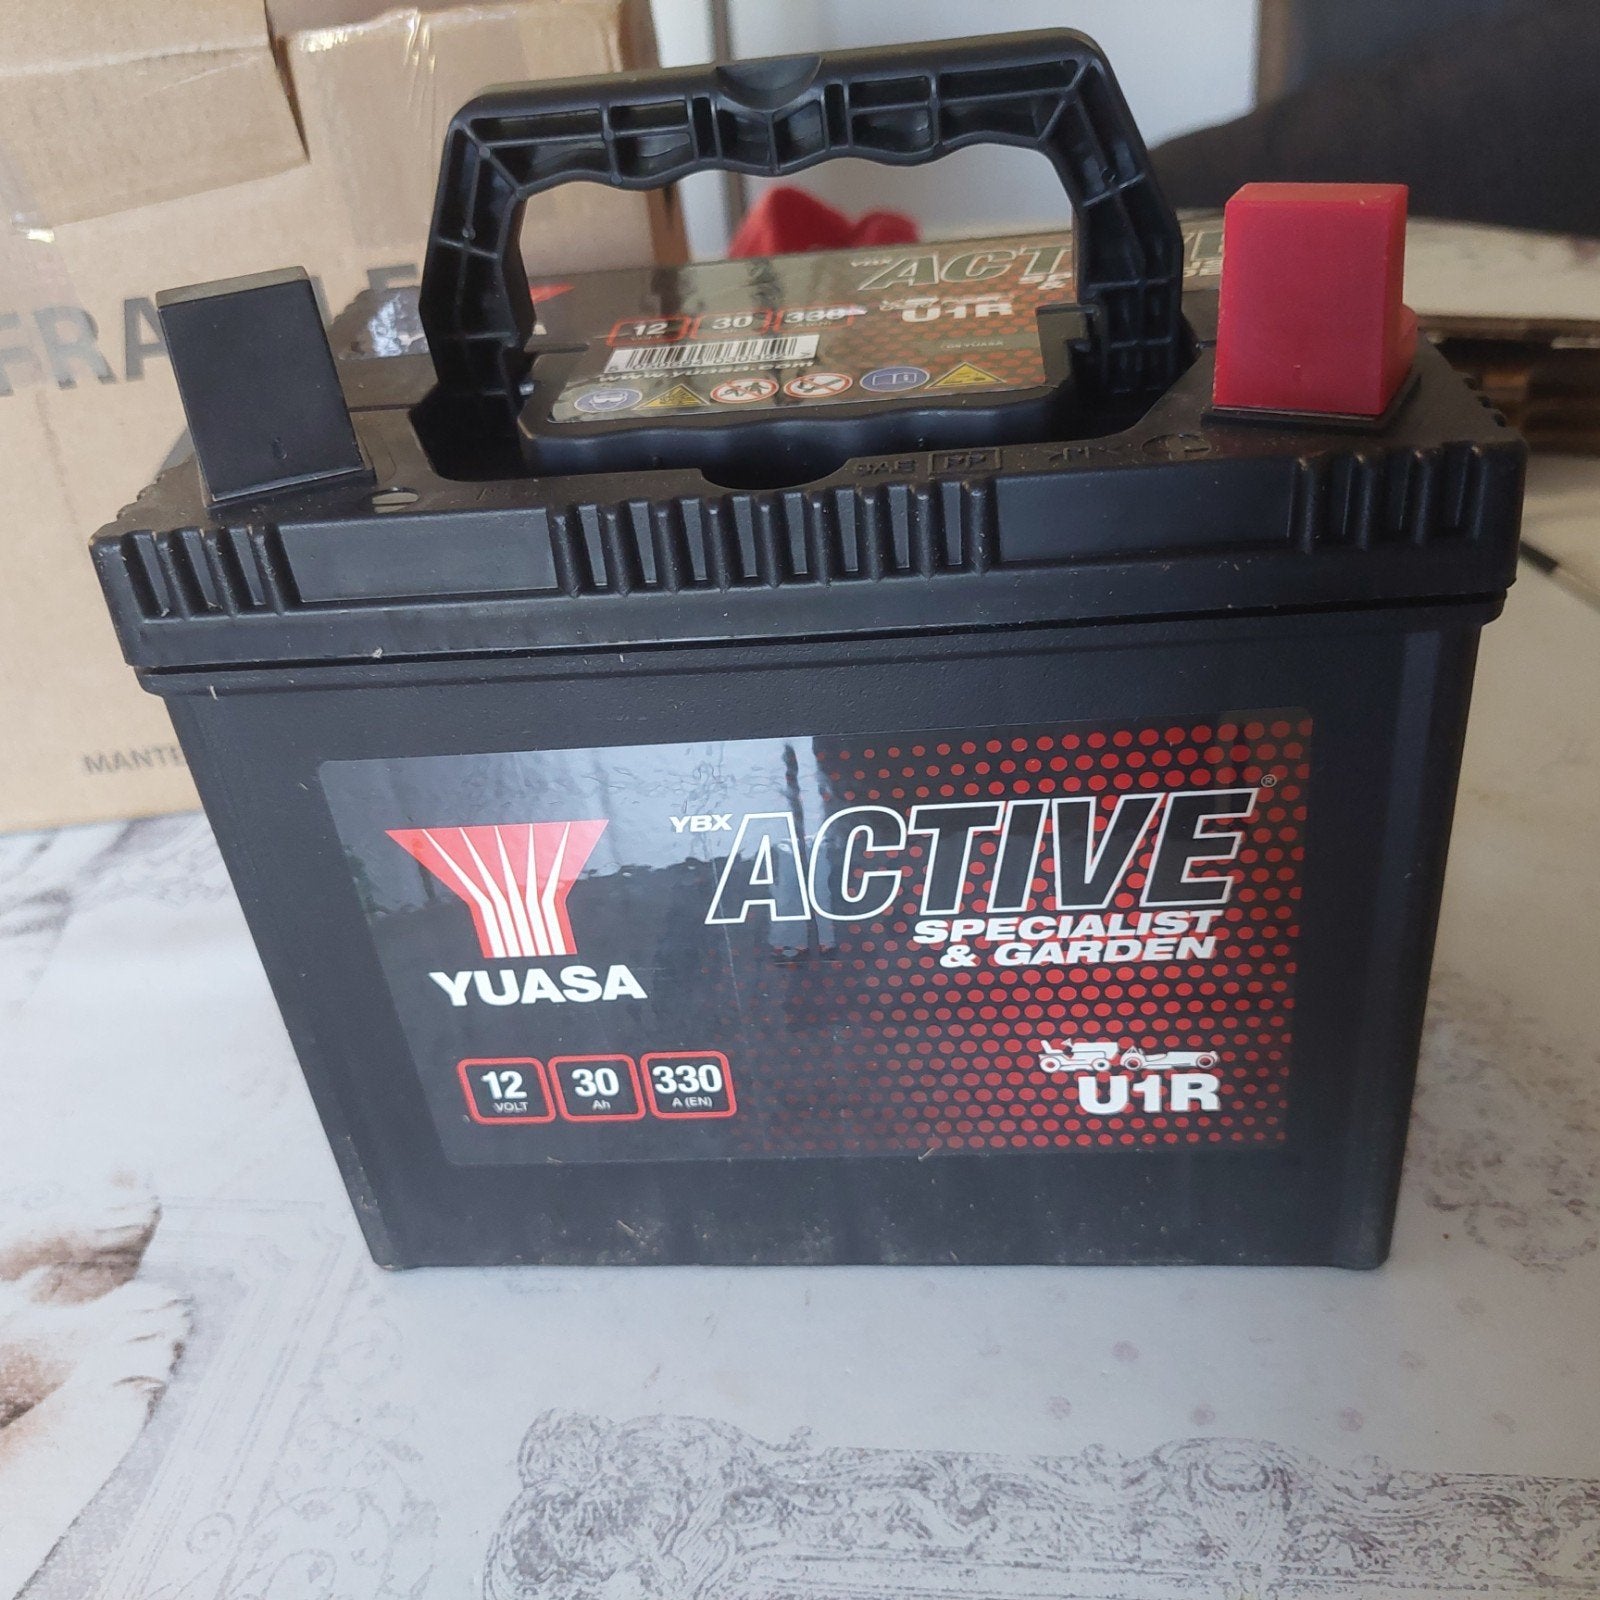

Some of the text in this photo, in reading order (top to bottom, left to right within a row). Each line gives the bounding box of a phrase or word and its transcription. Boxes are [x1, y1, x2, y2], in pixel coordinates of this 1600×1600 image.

[633, 321, 669, 336] 12
[712, 315, 753, 331] 30
[669, 813, 733, 833] YBX
[705, 788, 1259, 925] ACTIVE
[912, 909, 1224, 946] SPECIALIST
[939, 935, 1217, 969] & GARDEN
[428, 964, 648, 1007] YUASA
[481, 1070, 528, 1100] 12
[571, 1067, 620, 1097] 30
[652, 1063, 724, 1094] 330
[1077, 1072, 1222, 1115] U1R
[492, 1101, 528, 1114] VOLT
[592, 1099, 611, 1111] Ah
